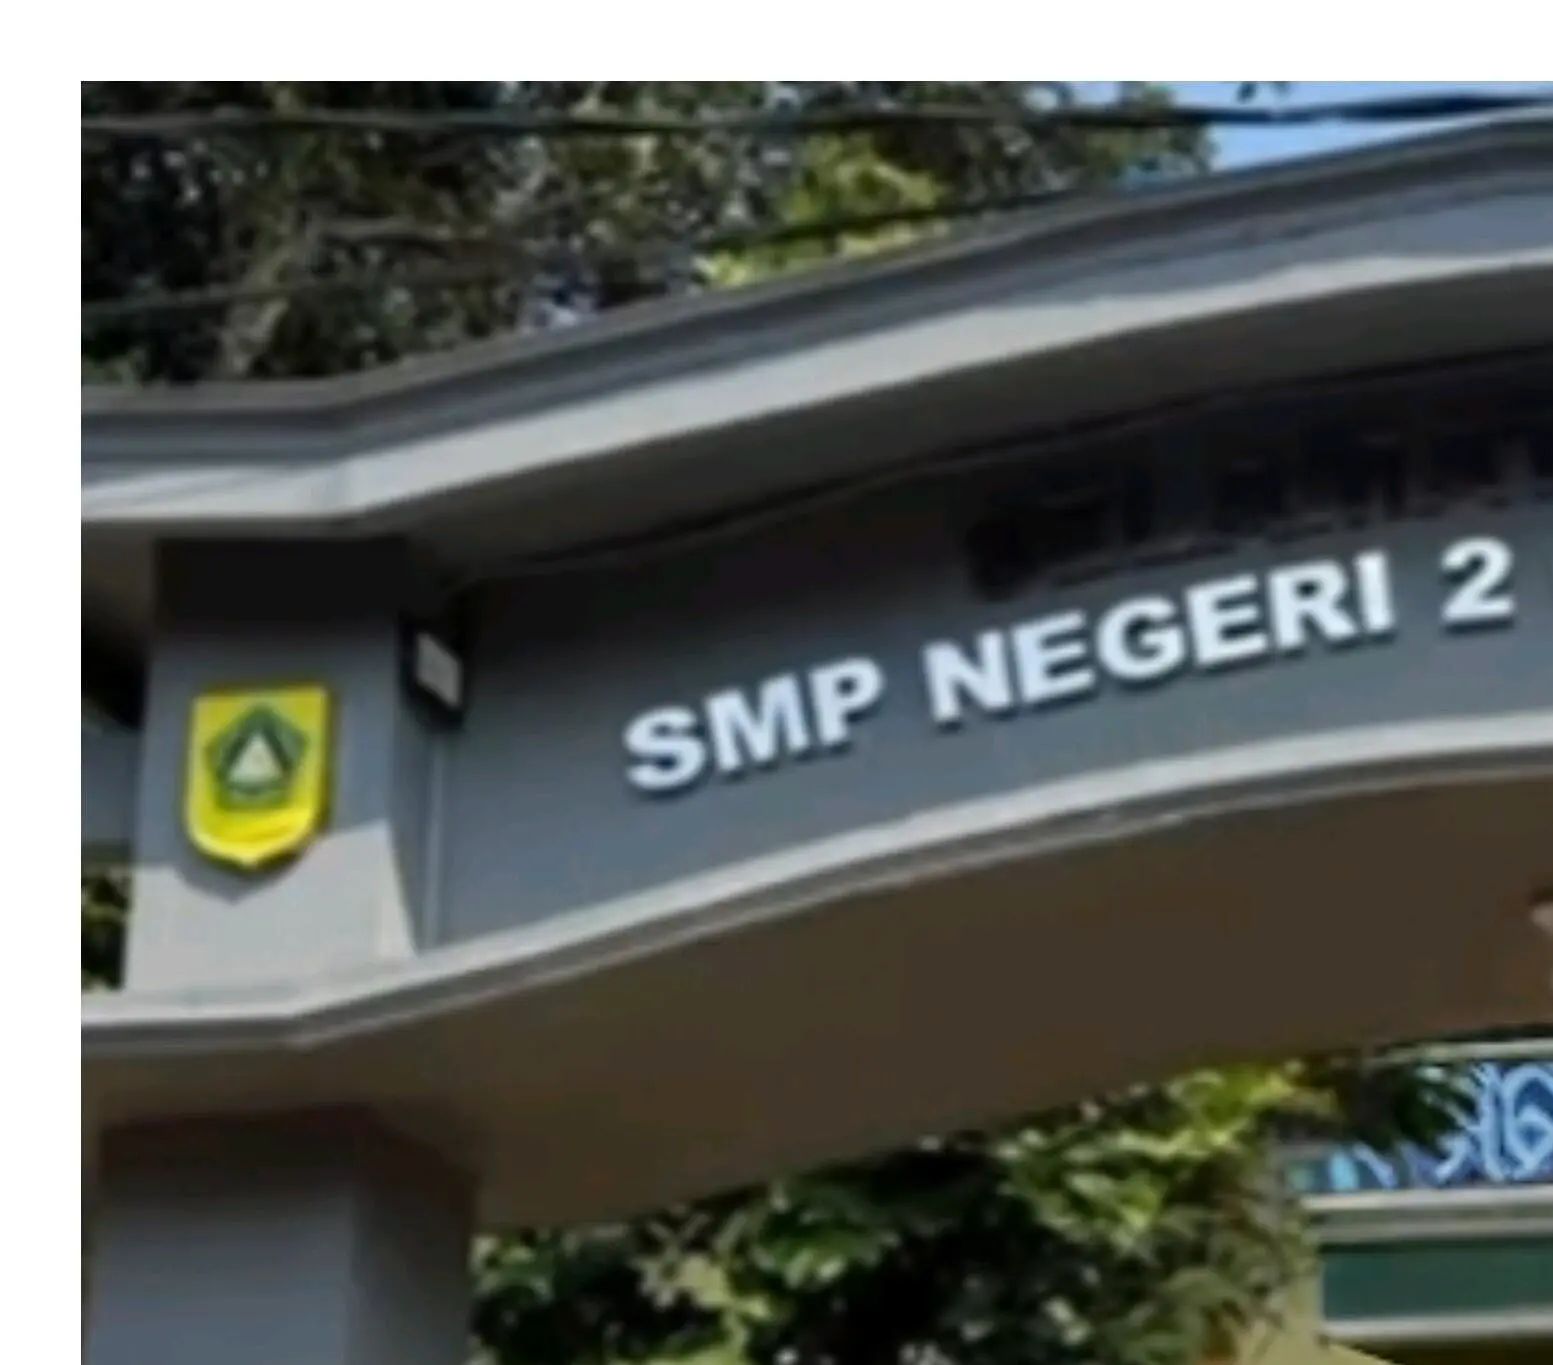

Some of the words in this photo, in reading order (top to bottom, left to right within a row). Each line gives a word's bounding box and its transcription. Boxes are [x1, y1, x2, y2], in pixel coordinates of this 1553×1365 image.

[622, 657, 886, 790] SMP
[923, 549, 1398, 722] NEGERI
[1440, 536, 1516, 624] 2
